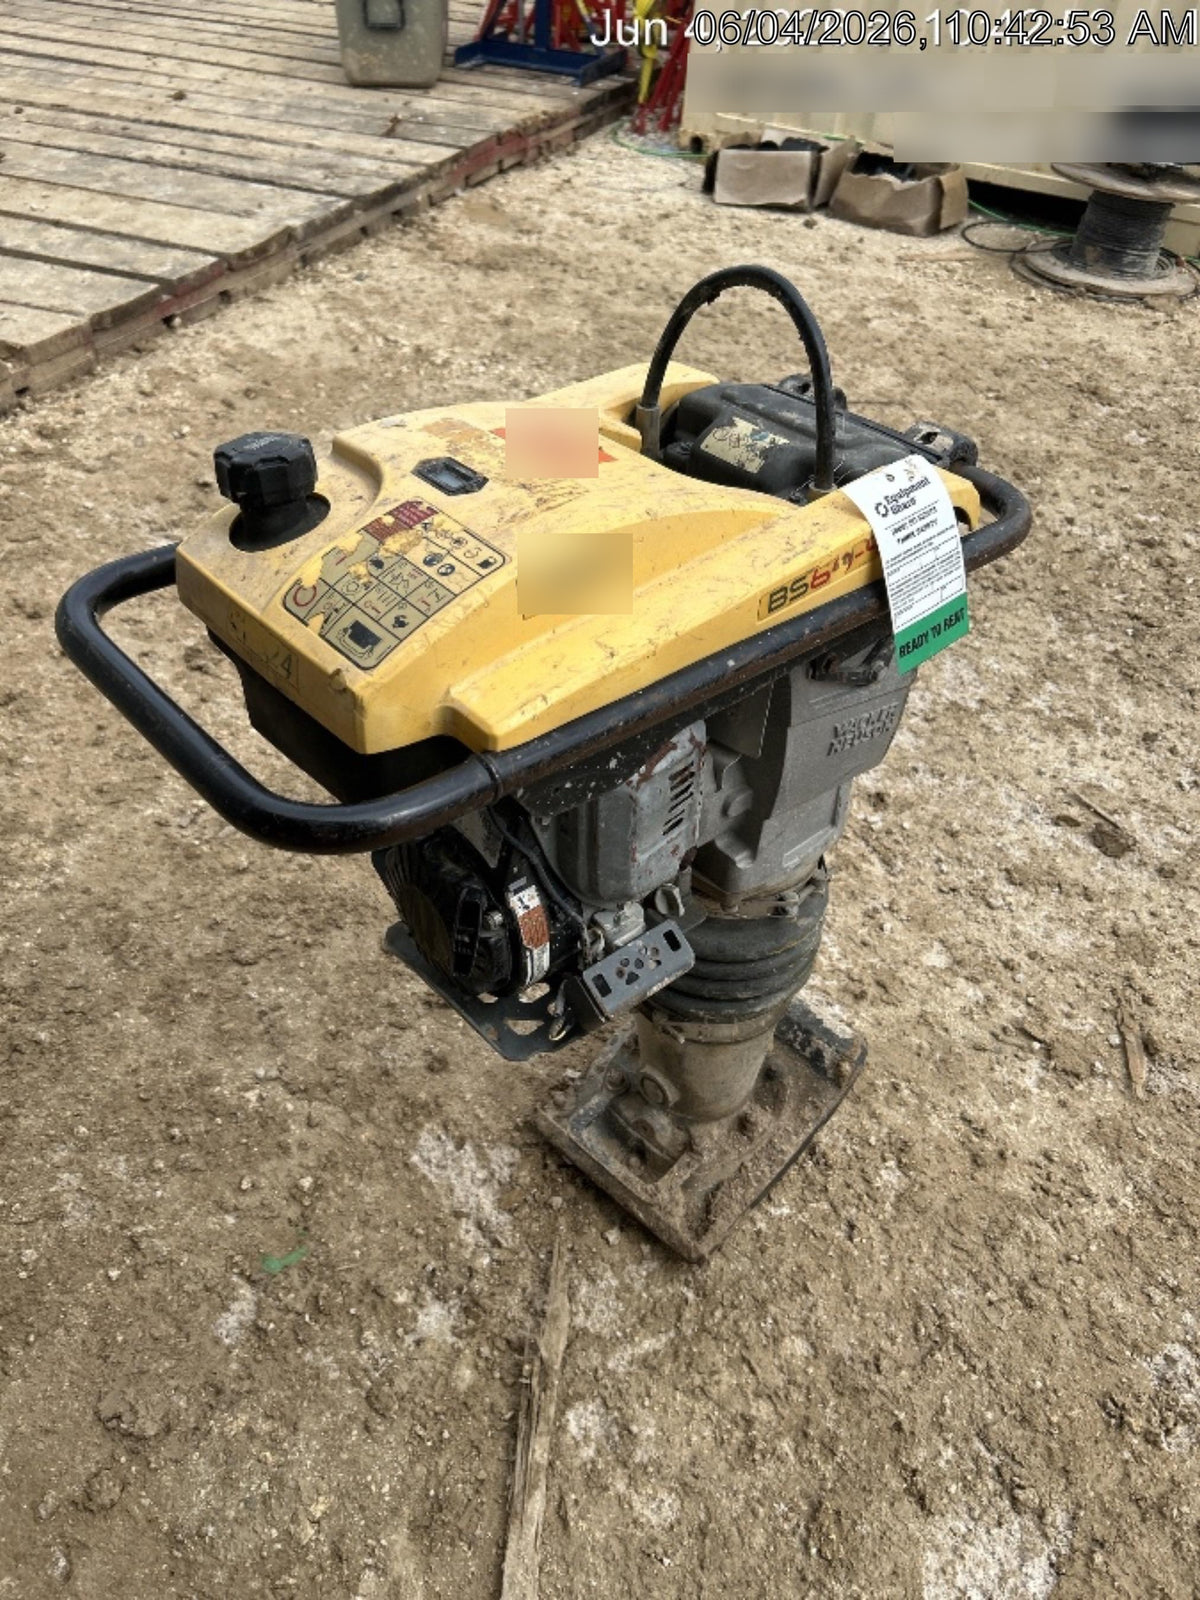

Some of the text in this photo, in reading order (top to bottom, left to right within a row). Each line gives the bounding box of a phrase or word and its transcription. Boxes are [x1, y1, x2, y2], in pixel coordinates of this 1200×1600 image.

[884, 476, 931, 505] Equipment
[898, 606, 966, 659] READY TO RENT
